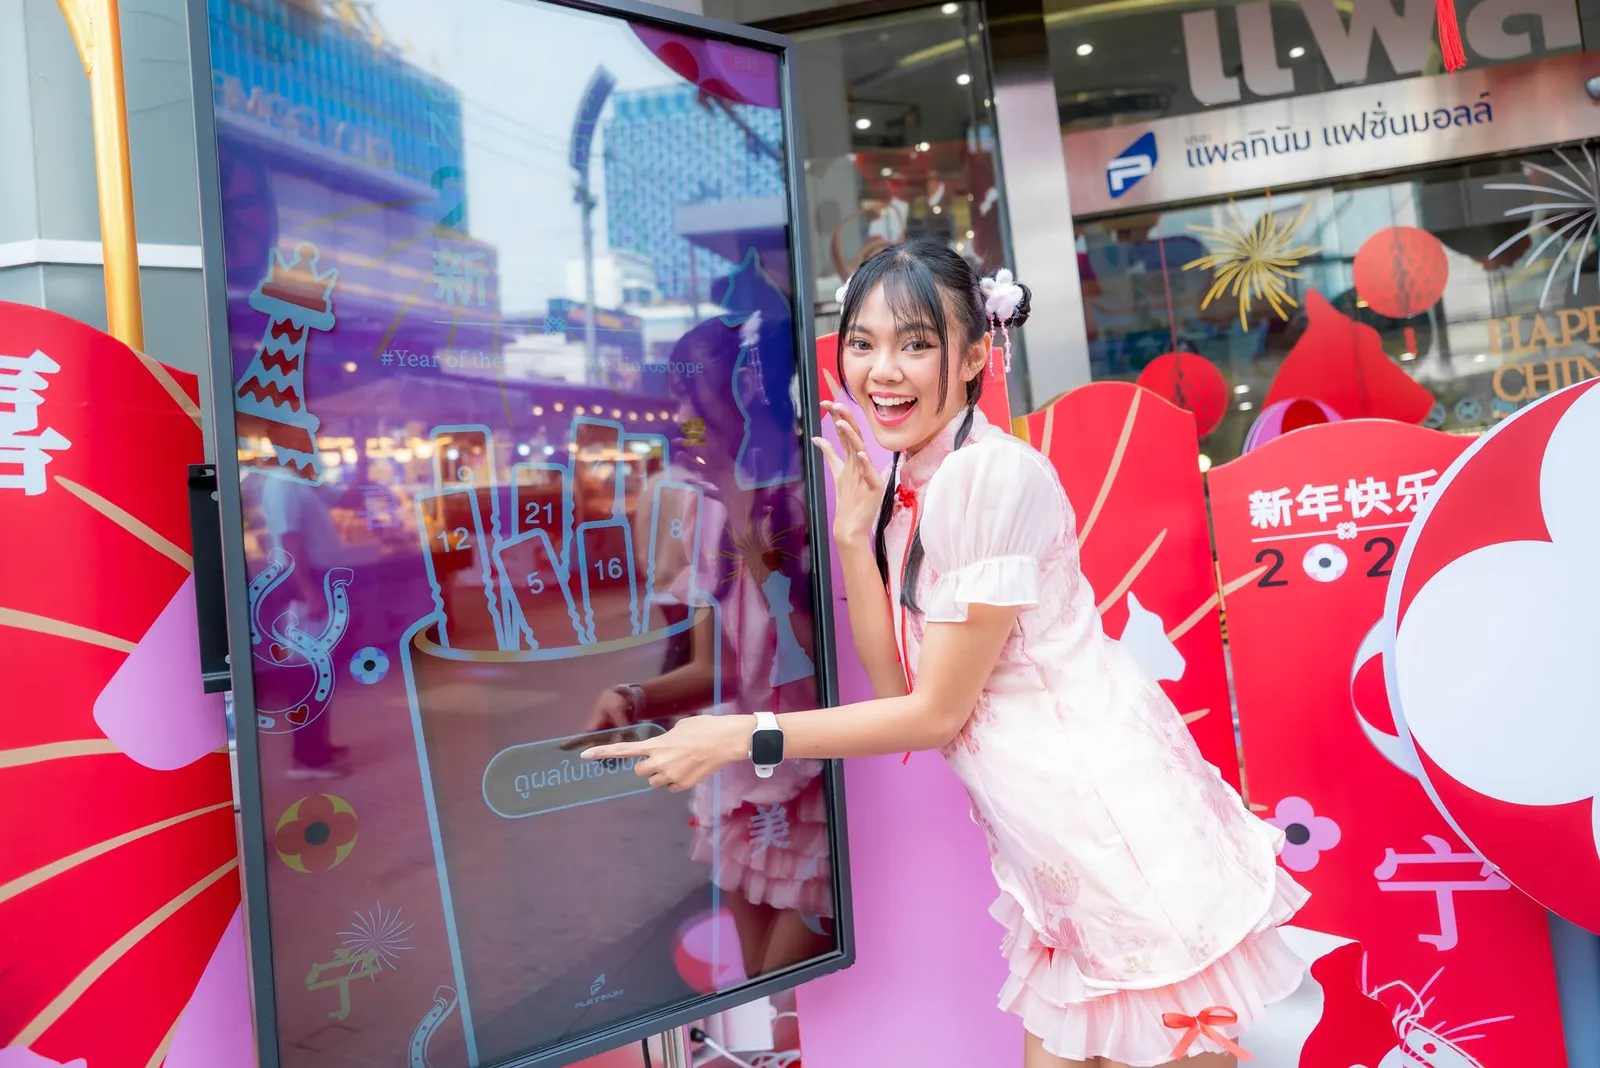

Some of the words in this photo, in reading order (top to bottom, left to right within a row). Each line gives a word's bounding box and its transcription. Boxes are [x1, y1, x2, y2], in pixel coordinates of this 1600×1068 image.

[1186, 125, 1312, 168] แพลทินัม
[1322, 91, 1494, 146] แฟชั่นมอลล์
[381, 349, 438, 369] #Year
[446, 350, 468, 369] of
[616, 356, 705, 378] Horoscope
[1248, 468, 1438, 530] 新年快乐
[525, 502, 552, 524] 21
[437, 526, 472, 553] 12
[670, 518, 684, 539] 8
[594, 557, 624, 581] 16
[526, 571, 545, 595] 5
